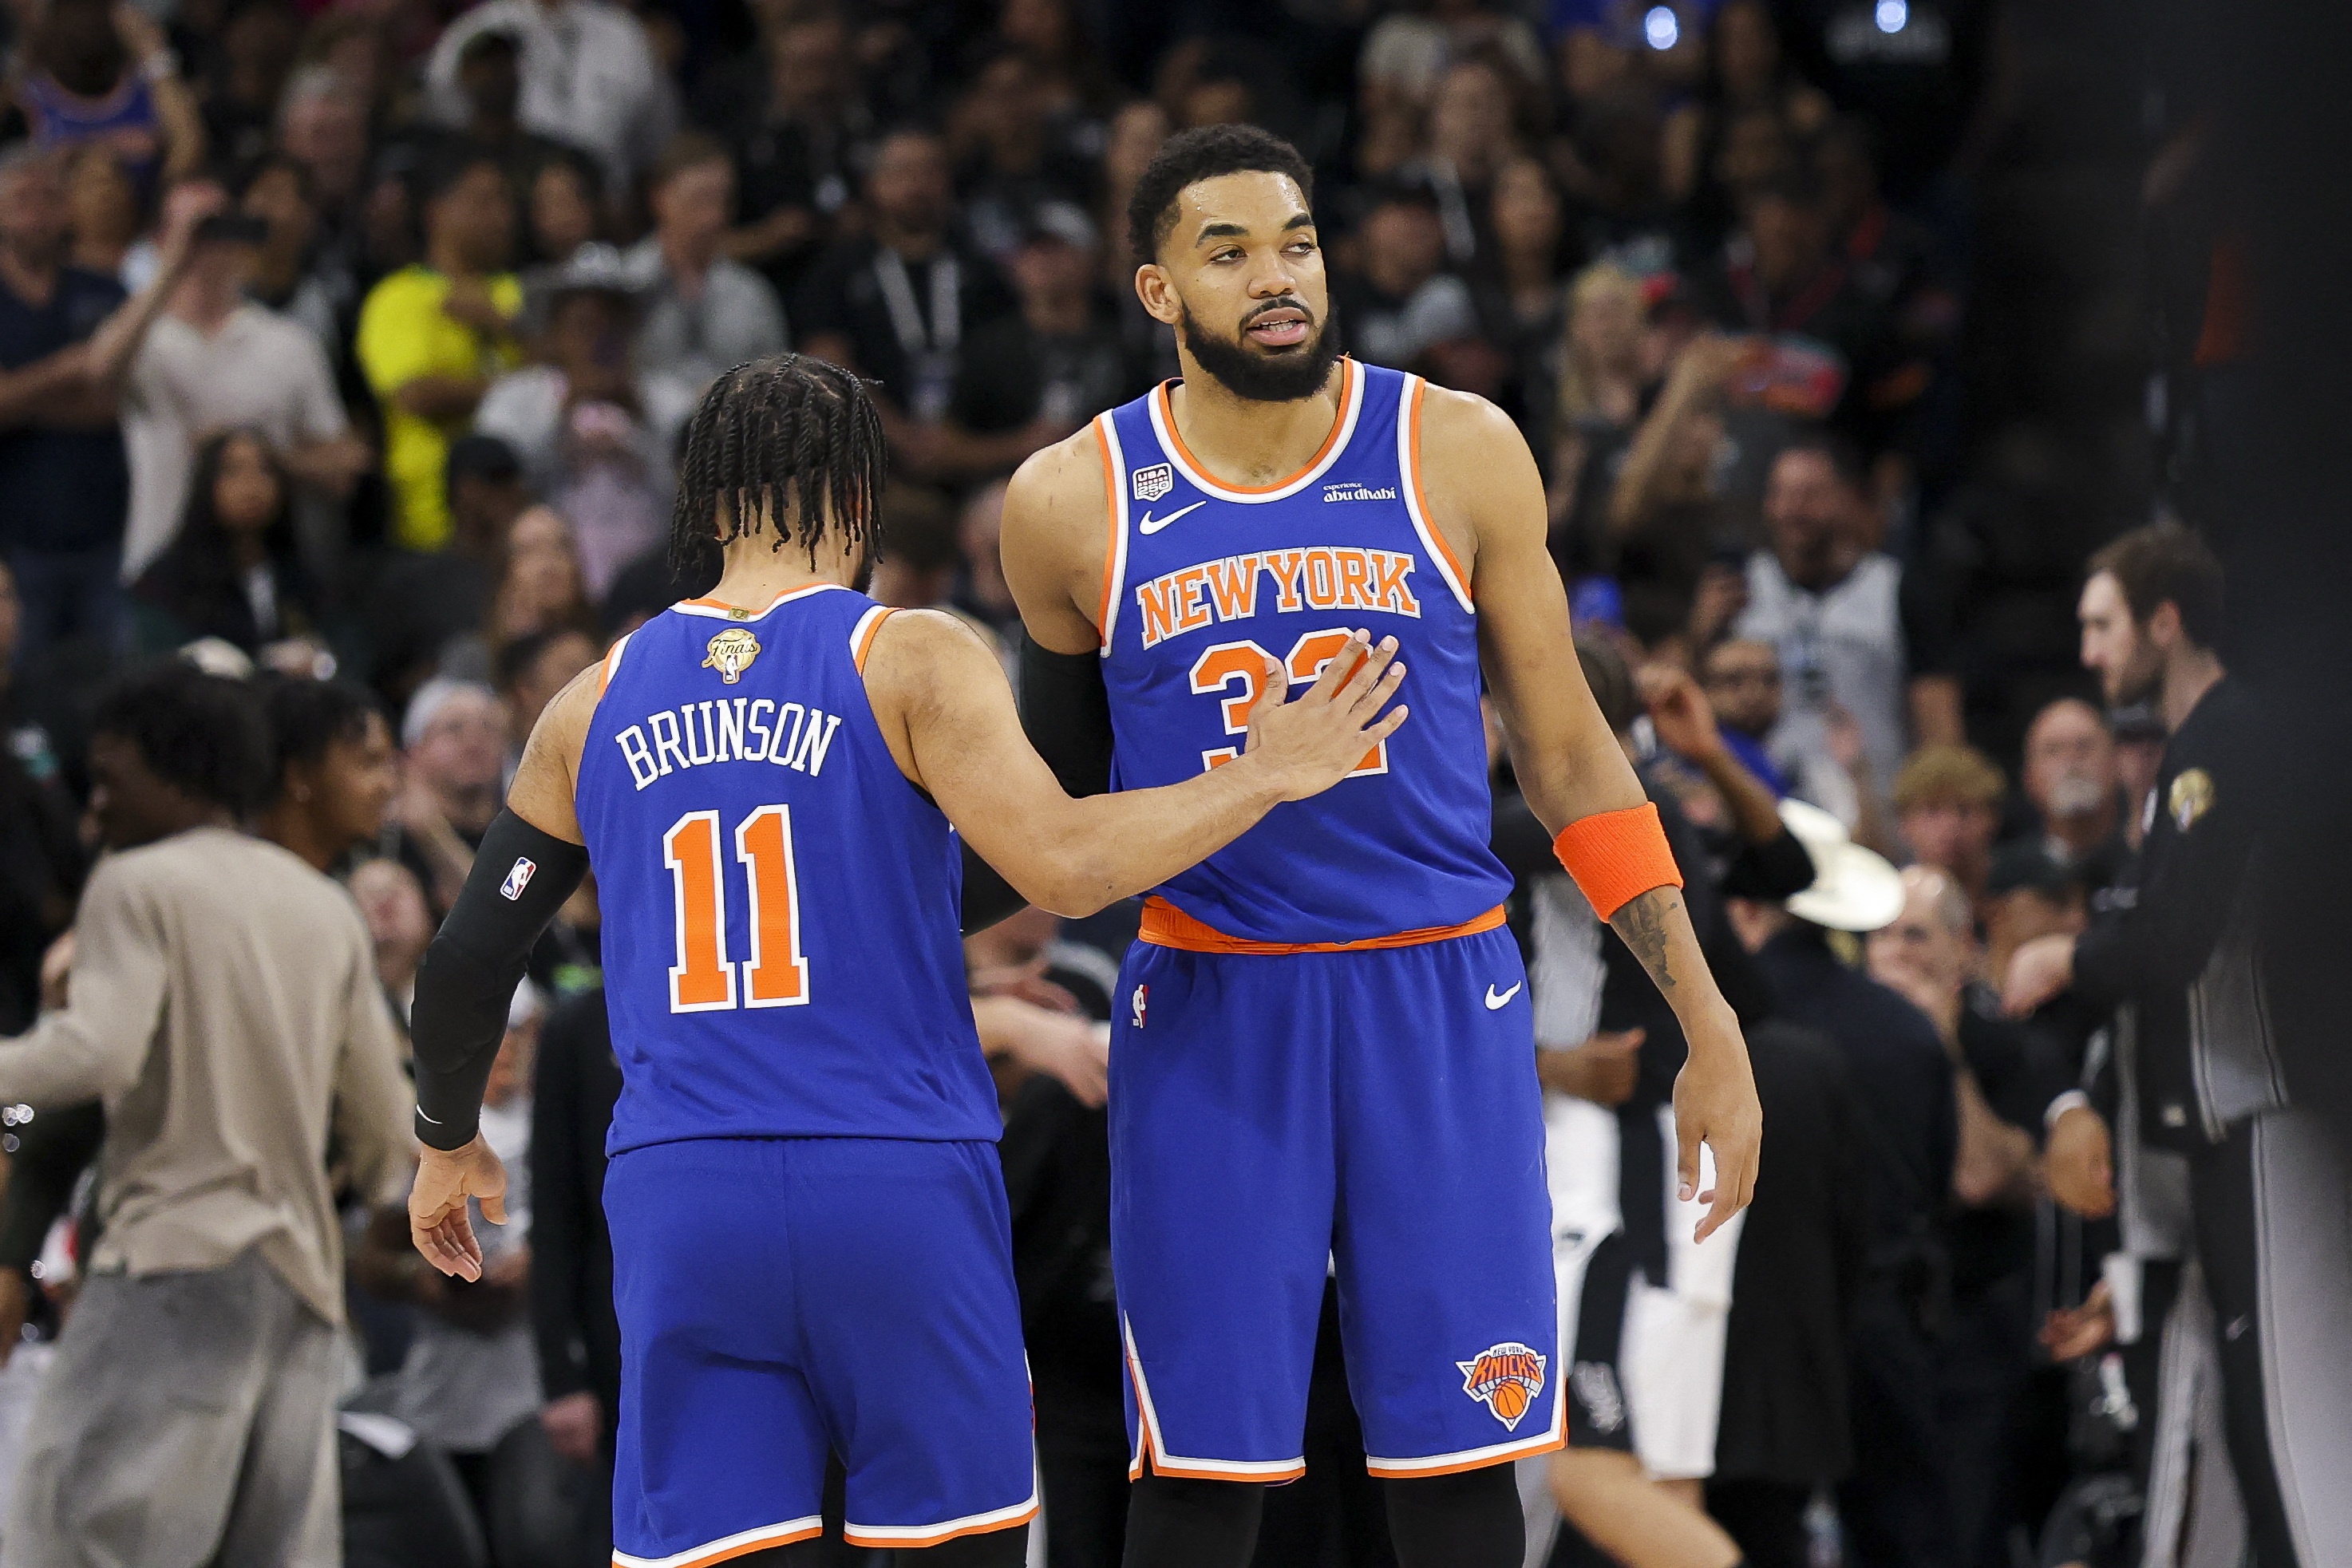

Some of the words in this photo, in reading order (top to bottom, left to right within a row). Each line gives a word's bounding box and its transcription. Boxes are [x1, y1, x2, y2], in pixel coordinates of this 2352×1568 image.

[1137, 480, 1171, 496] 250
[1322, 482, 1362, 491] experience
[1323, 490, 1353, 503] abu
[1354, 487, 1397, 500] dhabi
[1135, 555, 1260, 650] NEW
[1261, 546, 1421, 619] YORK
[704, 636, 759, 665] Finals
[615, 697, 842, 792] BRUNSON
[662, 804, 811, 1014] 11
[1492, 1347, 1507, 1357] NEW
[1508, 1346, 1524, 1355] YORK
[1468, 1352, 1543, 1390] KNICKS
